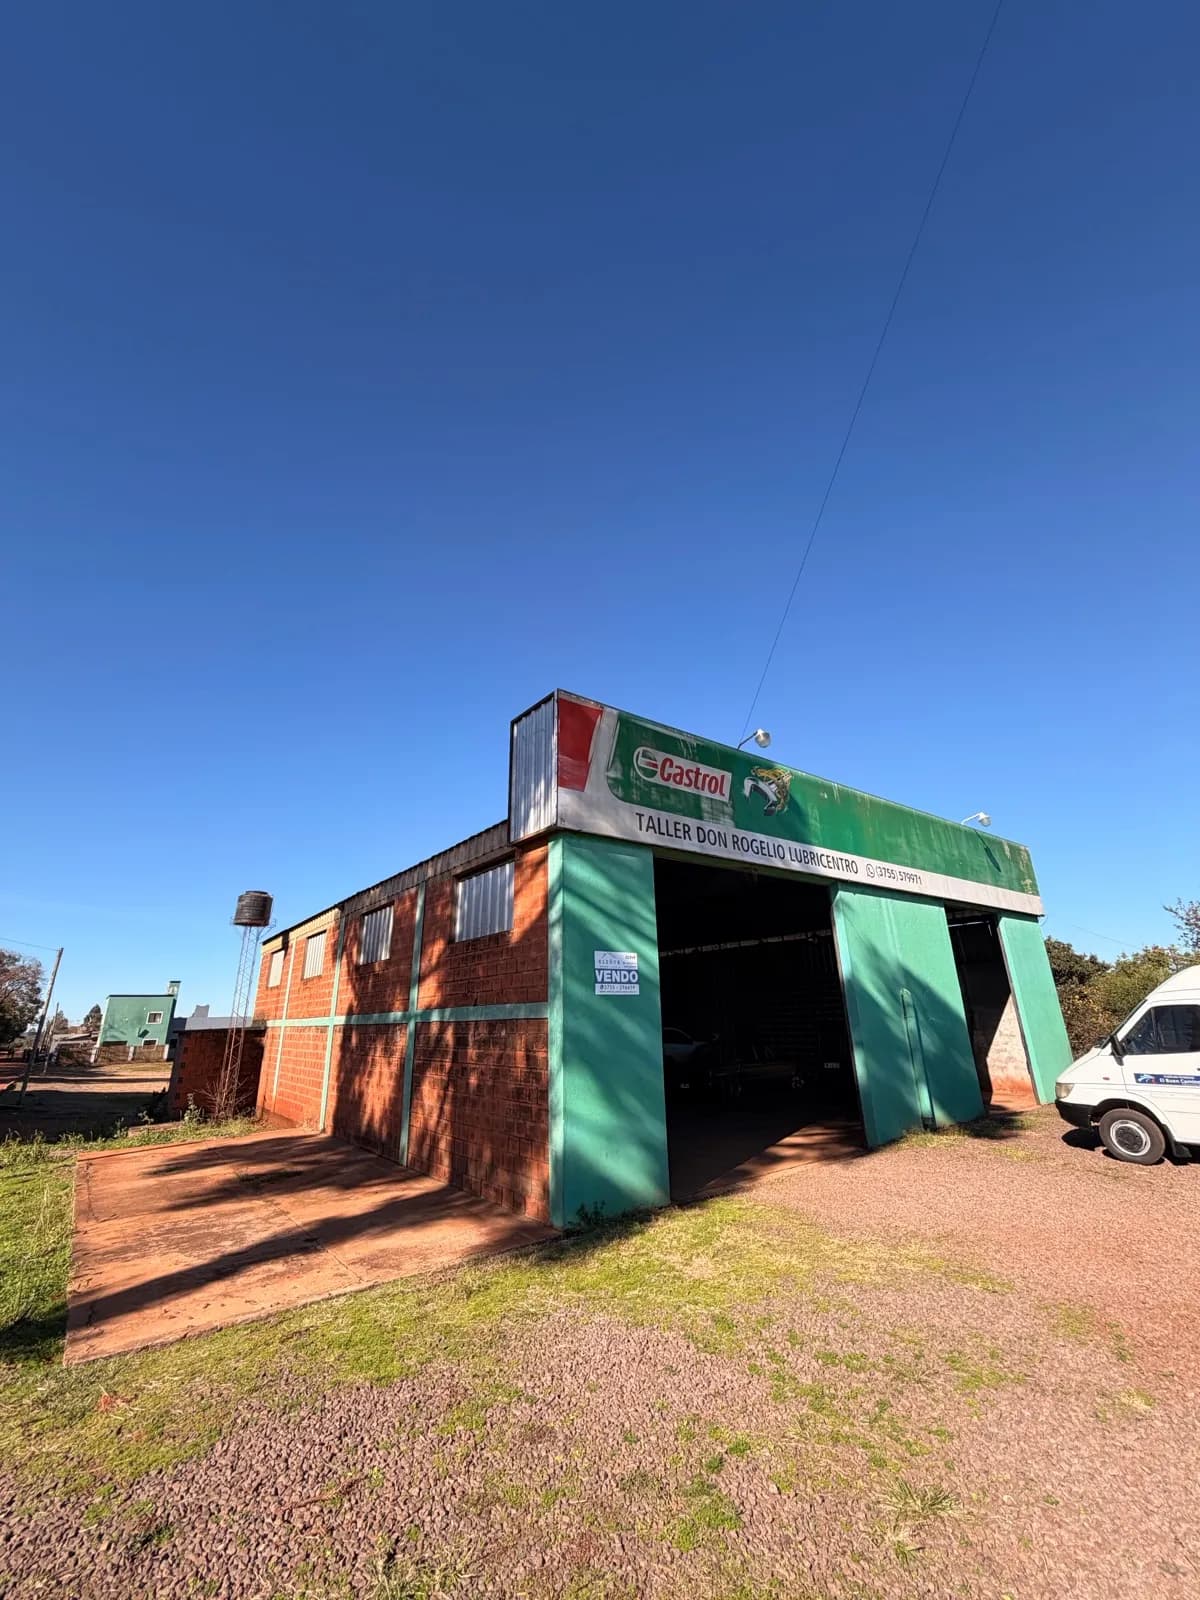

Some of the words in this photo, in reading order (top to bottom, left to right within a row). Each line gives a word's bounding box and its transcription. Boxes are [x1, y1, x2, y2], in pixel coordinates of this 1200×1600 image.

[660, 757, 725, 796] Castrol
[635, 812, 692, 841] TALLER
[696, 826, 728, 849] DON
[731, 834, 786, 860] ROGELIO
[788, 846, 859, 874] LUBRICENTRO
[875, 864, 899, 881] (3755)
[898, 871, 923, 885] 579971
[595, 969, 639, 983] VENDO
